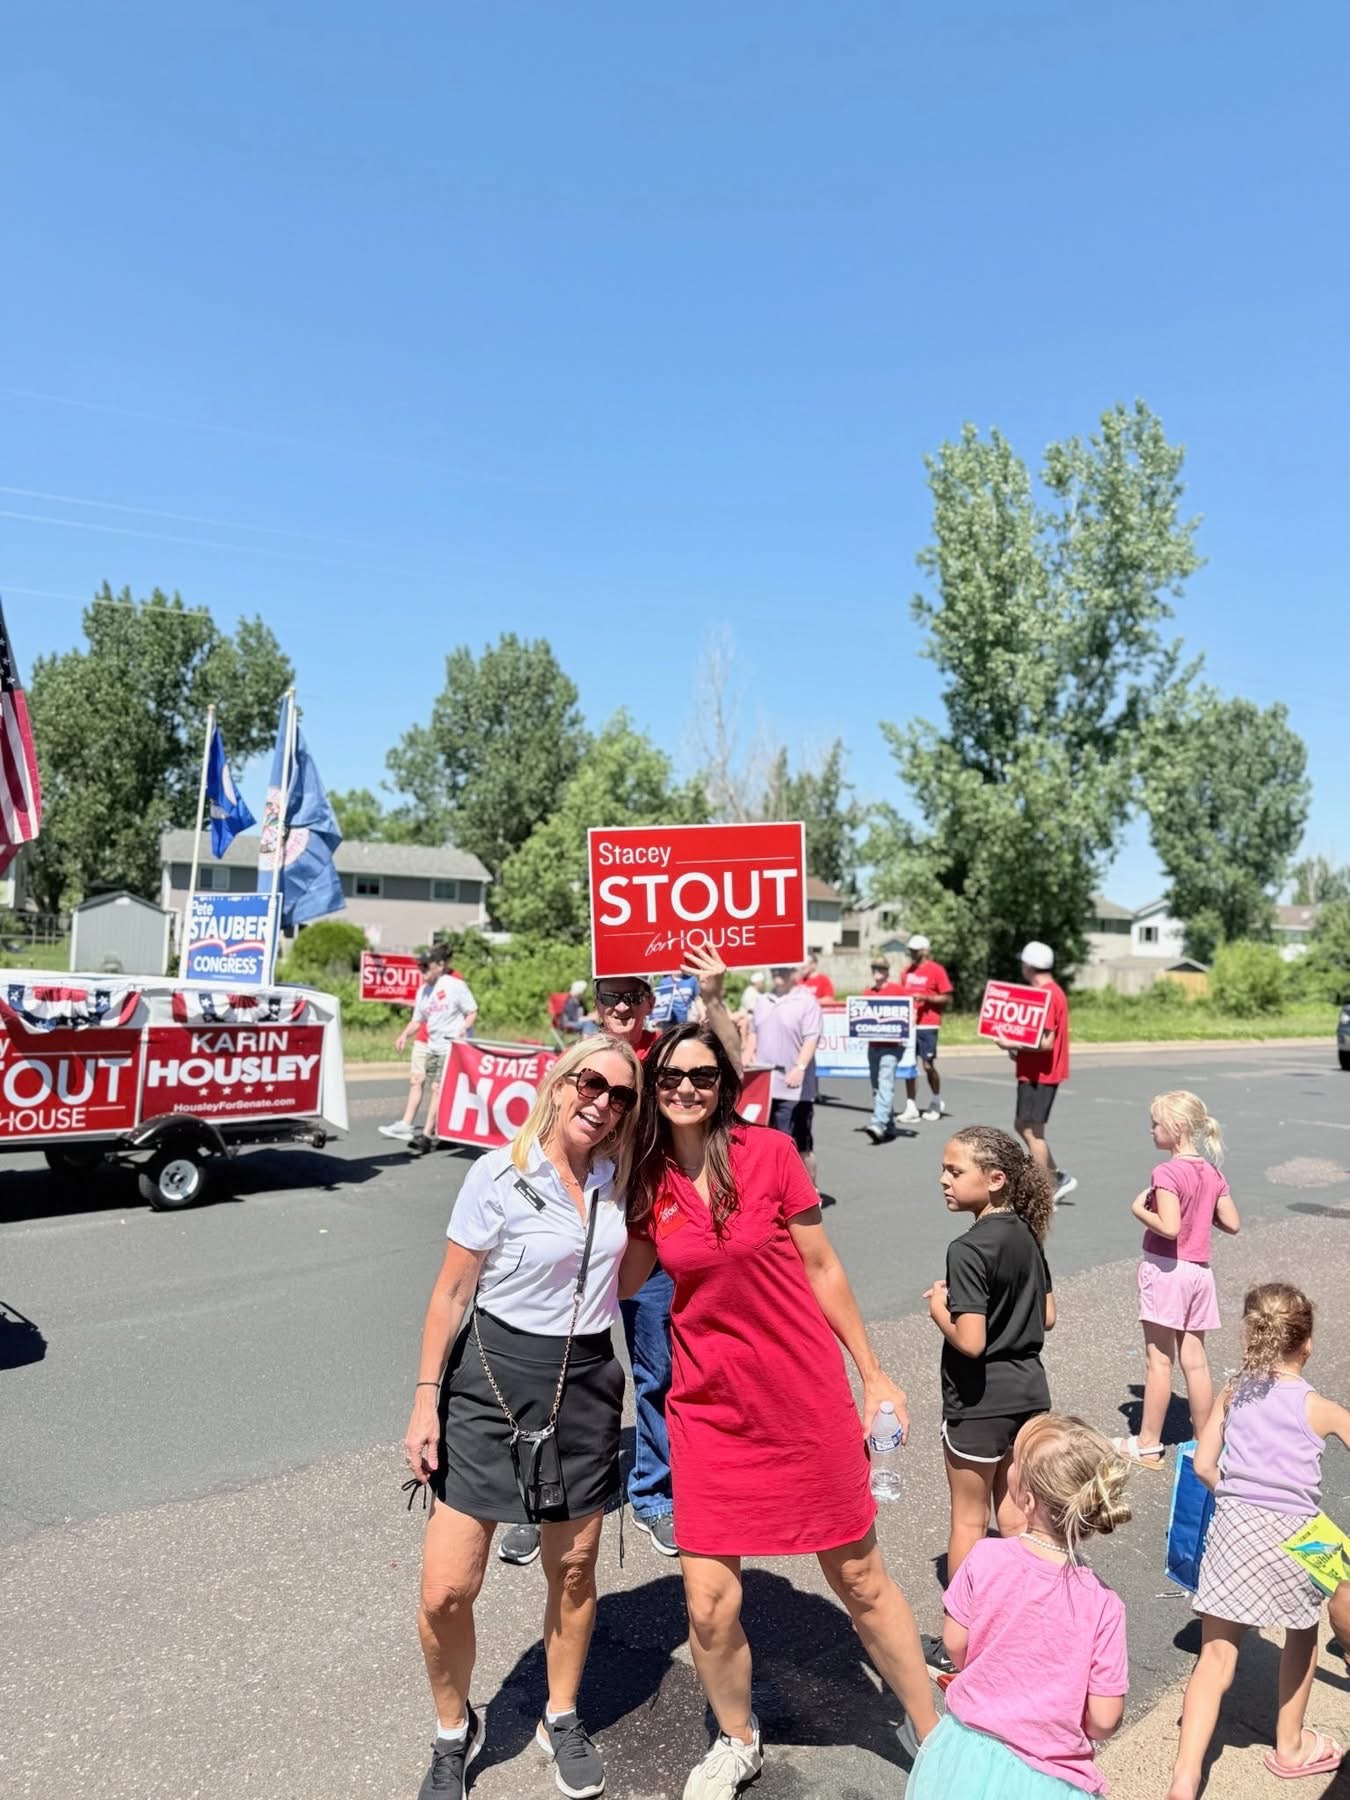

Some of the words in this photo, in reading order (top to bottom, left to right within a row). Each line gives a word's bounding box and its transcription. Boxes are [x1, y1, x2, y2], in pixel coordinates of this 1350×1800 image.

[599, 842, 671, 867] Stacey
[192, 900, 214, 916] Pete
[599, 868, 797, 926] STOUT
[190, 915, 270, 940] STAUBER
[667, 926, 756, 950] HOUSE
[193, 956, 257, 975] CONGRESS
[363, 967, 421, 985] STOUT
[983, 998, 1044, 1027] STOUT
[191, 1031, 289, 1053] KARIN
[147, 1055, 320, 1088] HOUSLEY
[478, 1054, 539, 1079] STATE
[0, 1058, 133, 1108] OUT
[173, 1098, 296, 1113] HousleyForSenate.com
